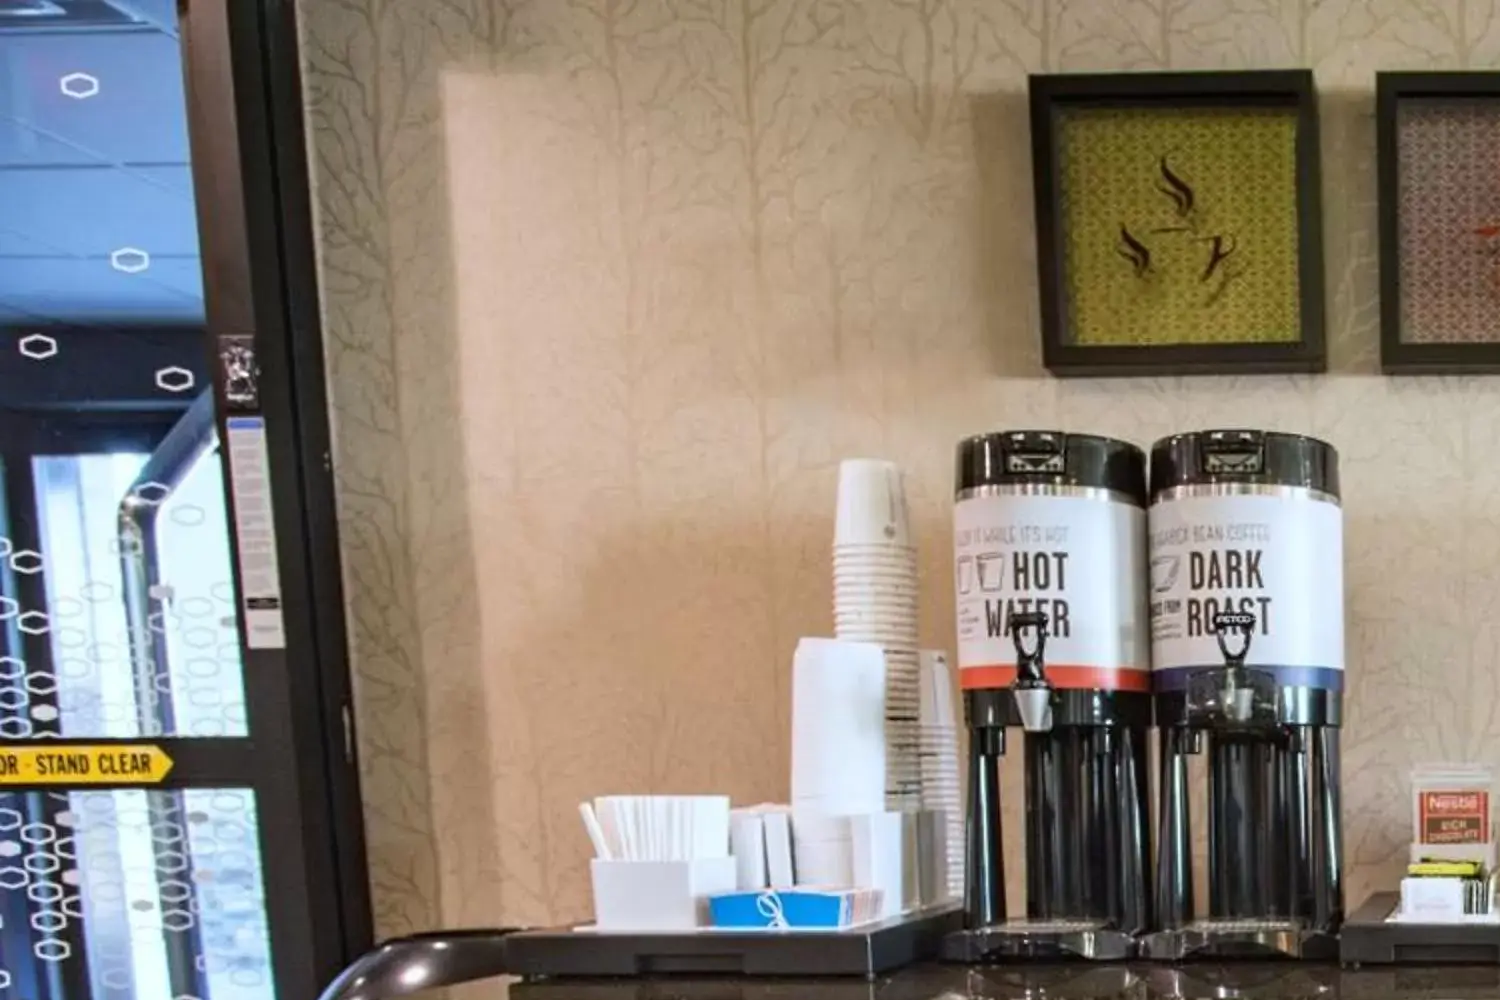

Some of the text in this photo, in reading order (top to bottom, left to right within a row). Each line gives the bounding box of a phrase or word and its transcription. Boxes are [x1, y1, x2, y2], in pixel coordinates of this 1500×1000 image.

[1013, 550, 1069, 591] HOT
[1189, 549, 1265, 591] DARK
[36, 753, 90, 776] STAND
[98, 752, 151, 775] CLEAR
